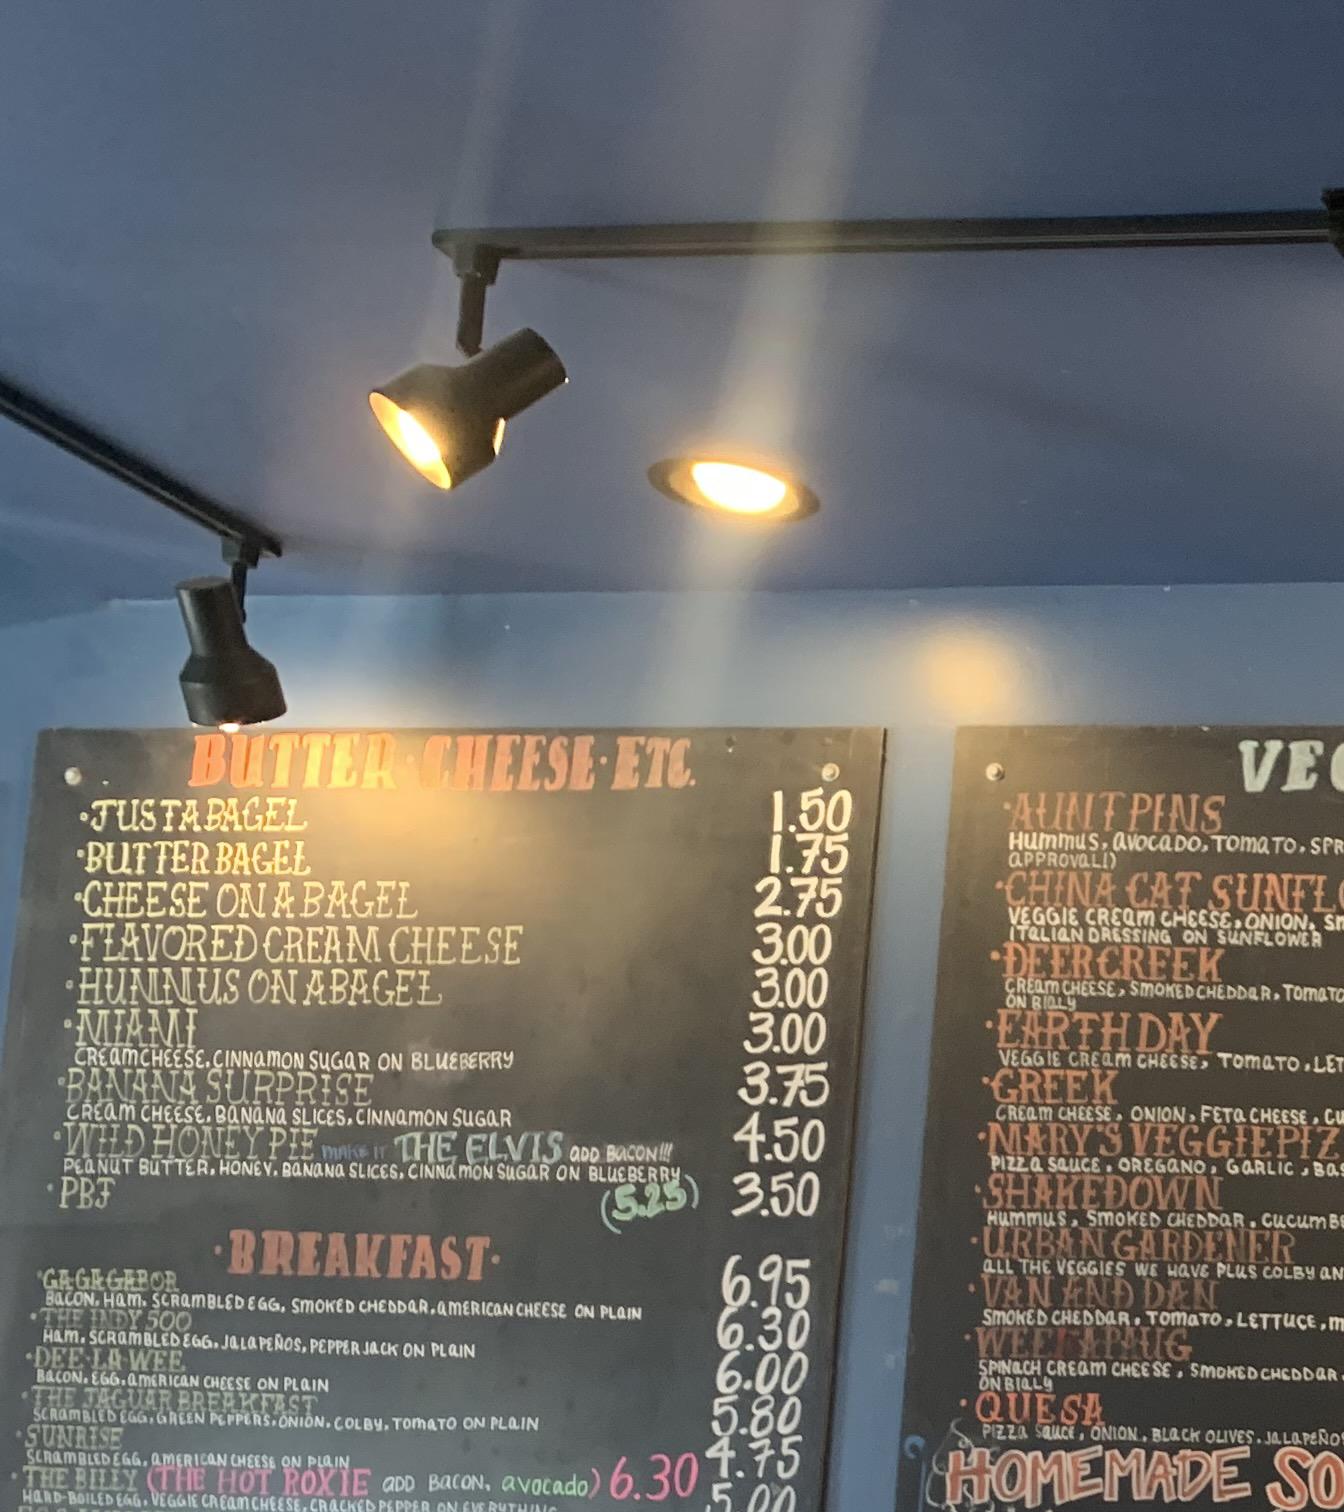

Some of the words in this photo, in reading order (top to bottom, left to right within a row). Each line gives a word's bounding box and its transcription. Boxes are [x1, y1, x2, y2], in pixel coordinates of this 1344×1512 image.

[188, 732, 398, 790] BUTTER
[773, 788, 852, 832] 1.50
[1007, 792, 1126, 832] AUNT
[84, 840, 209, 875] BUTTER
[216, 840, 311, 875] BAGEL
[771, 833, 849, 874] 1.75
[82, 881, 208, 917] CHEESE
[217, 882, 267, 918] ON
[301, 881, 418, 918] BAGEL
[754, 876, 843, 918] 2.75
[1006, 871, 1115, 909] CHINA
[1126, 872, 1201, 911] CAT
[81, 923, 257, 962] FLAVORED
[263, 926, 381, 963] CREAM
[389, 926, 524, 965] CHEESE
[1183, 930, 1208, 944] ON
[75, 1009, 198, 1048] MIAMI
[996, 1010, 1131, 1050] EARTH
[1139, 1012, 1223, 1054] DAY
[378, 1052, 402, 1071] ON
[65, 1069, 198, 1103] BANANA
[207, 1073, 373, 1106] SURPRISE
[991, 1069, 1119, 1104] GREEK
[394, 1132, 458, 1162] THE
[466, 1131, 564, 1163] ELVIS
[733, 1112, 825, 1163] 4.50
[60, 1177, 115, 1209] PBJ
[731, 1172, 820, 1218] 3.50
[982, 1176, 1223, 1210] SHAKEDOWN
[228, 1229, 491, 1280] BREAKFAST
[722, 1254, 810, 1309] 6.95
[712, 1395, 801, 1438] 5.80
[975, 1393, 1103, 1426] QUESA
[25, 1427, 123, 1449] SUNRISE
[217, 1468, 271, 1495] HOT
[283, 1468, 370, 1497] ROXIE
[610, 1453, 698, 1500] 6.30
[945, 1445, 1252, 1506] HOMEMADE
